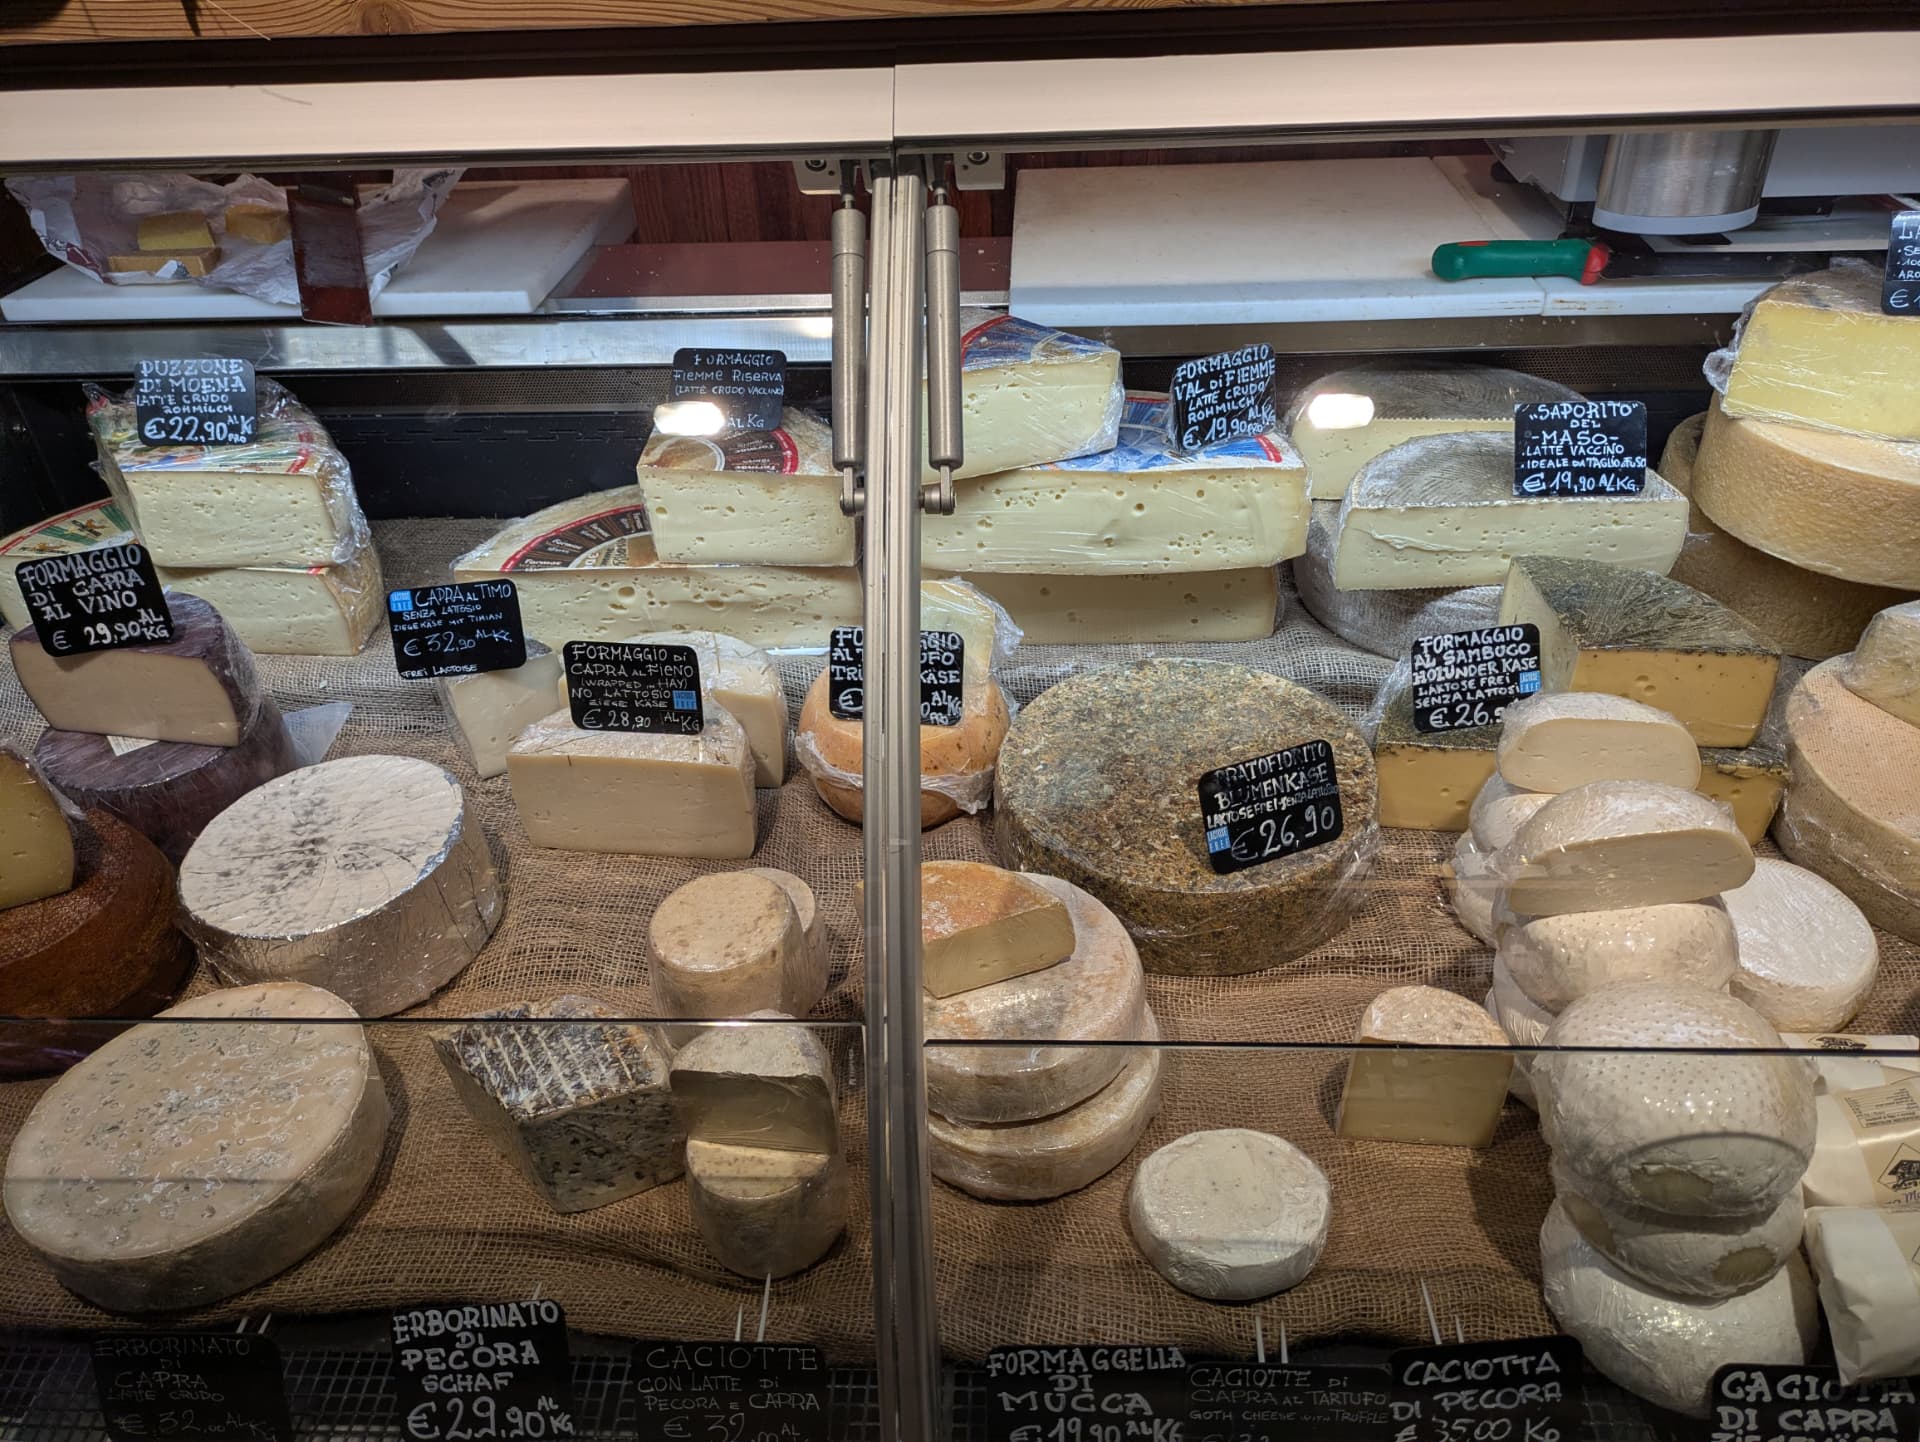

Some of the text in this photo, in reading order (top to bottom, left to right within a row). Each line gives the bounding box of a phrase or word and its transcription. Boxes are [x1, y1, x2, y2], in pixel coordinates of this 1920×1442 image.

[140, 358, 245, 377] PUZZONE
[1176, 344, 1269, 382] FORMAGGIO
[169, 375, 247, 394] MOENA
[711, 386, 745, 394] CRUDO
[1174, 379, 1205, 401] VAL
[1224, 358, 1276, 387] FIEMME
[136, 393, 229, 406] LATTE CRUDO
[1188, 381, 1265, 412] LATTE CRUDO
[162, 403, 233, 414] ROHMILCH
[1187, 396, 1255, 425] ROHMILCH
[1569, 419, 1601, 428] DEL
[1570, 443, 1625, 457] VACCINO
[19, 544, 142, 592] FORMAGGIO
[72, 568, 145, 597] CAPRA
[40, 590, 138, 621] AL VINO
[415, 585, 464, 607] CAPRA
[466, 592, 479, 601] AL
[474, 583, 512, 600] TIMO
[136, 608, 165, 625] AL
[402, 604, 482, 621] SENZA LATTOSIO
[140, 624, 170, 641] KG
[1418, 626, 1524, 654] FORMAGGIO
[571, 642, 668, 661] FORMAGGIO
[1442, 643, 1531, 666] SAMBUCO
[570, 662, 628, 677] CAPRA
[631, 668, 646, 677] AL
[571, 687, 671, 699] NO LATTOSIO
[1415, 692, 1463, 709] SENZA
[664, 711, 680, 722] AL
[680, 715, 700, 732] KG
[392, 1300, 559, 1344] ERBORINATO
[95, 1336, 251, 1357] ERBORINATO
[455, 1331, 484, 1349] DI
[401, 1339, 540, 1372] PECORA
[646, 1345, 819, 1370] CACIOTTE
[986, 1347, 1186, 1377] FORMAGGELLA
[1402, 1351, 1561, 1387] CACIOTTA
[115, 1371, 209, 1390] CAPRA
[421, 1371, 514, 1394] SCHAF
[637, 1375, 682, 1393] CON
[691, 1372, 743, 1392] LATTE
[1048, 1374, 1094, 1392] DI
[644, 1395, 720, 1411] PECORA
[749, 1392, 821, 1412] CAPRA
[997, 1390, 1154, 1415] MUCCA
[1191, 1389, 1387, 1406] CAPRA AL TARTUFO
[1388, 1381, 1563, 1420] DI PECORA
[1716, 1405, 1899, 1434] DI CAPRA
